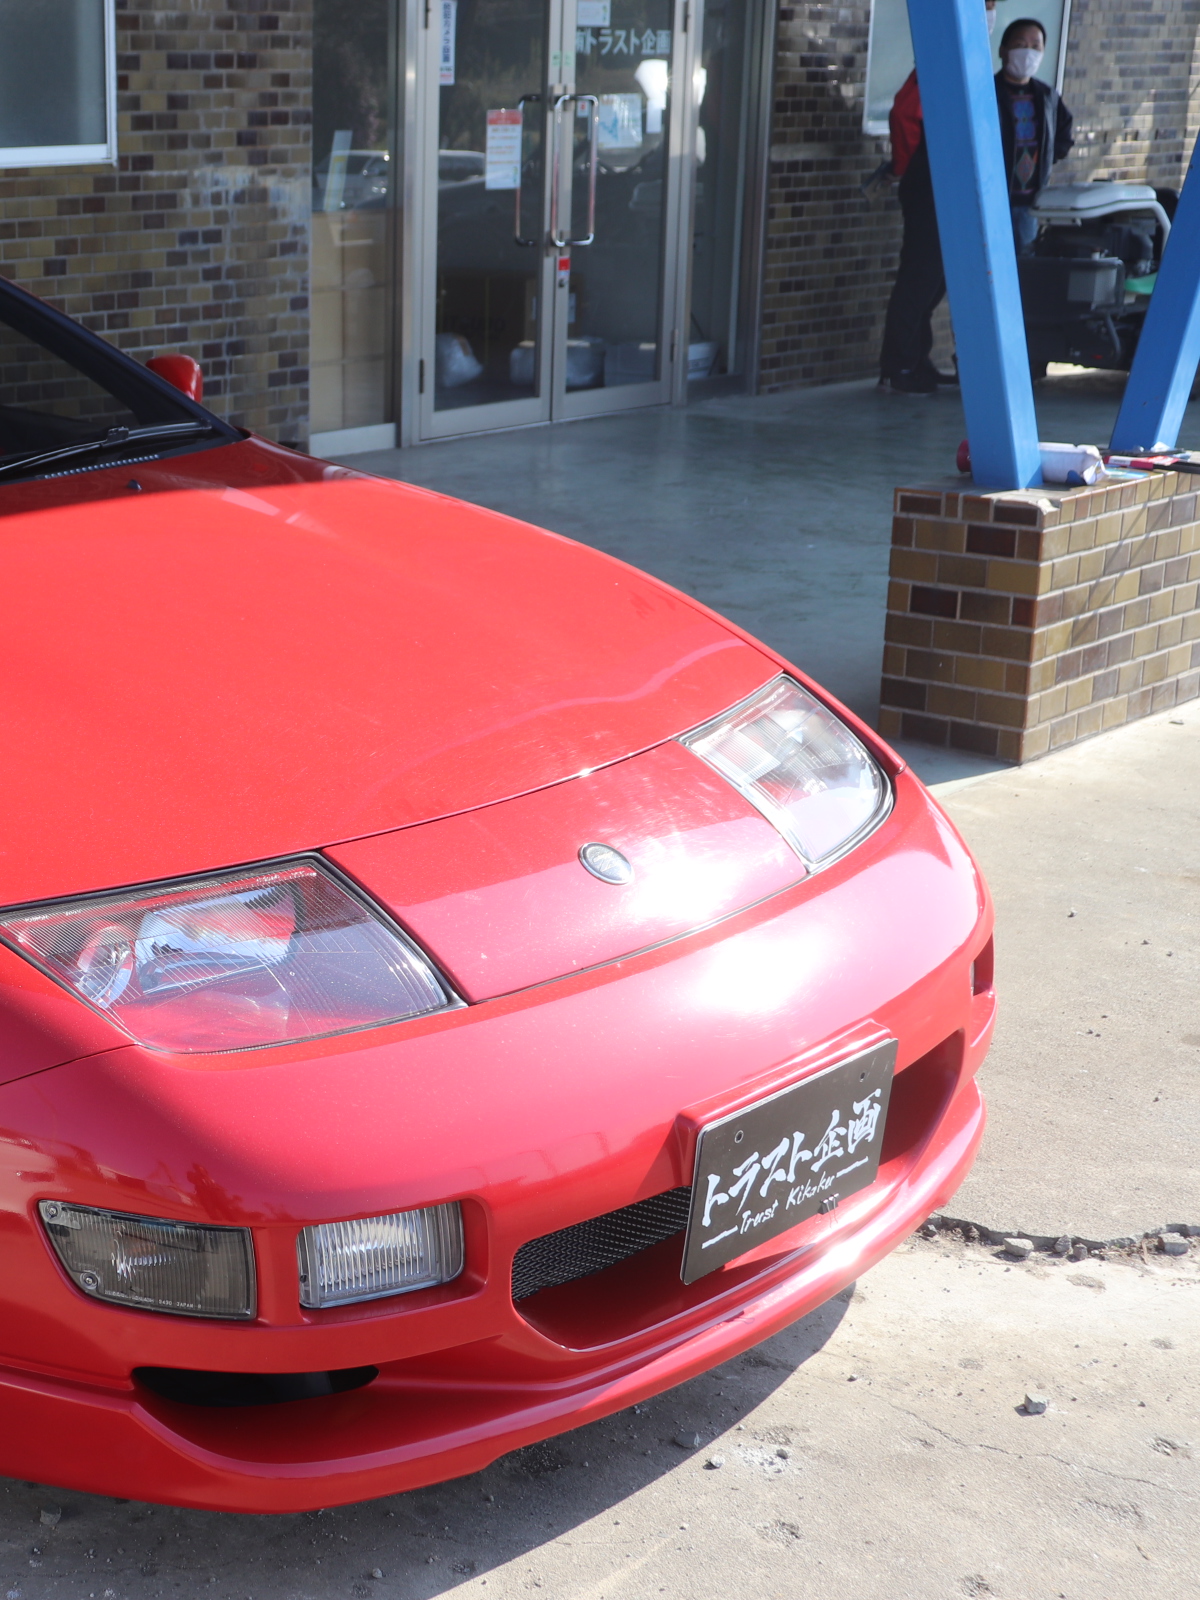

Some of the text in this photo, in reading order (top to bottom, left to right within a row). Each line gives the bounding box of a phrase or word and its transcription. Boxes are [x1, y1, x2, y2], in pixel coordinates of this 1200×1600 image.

[701, 1088, 881, 1227] トラスト企画
[740, 1199, 779, 1235] Trust
